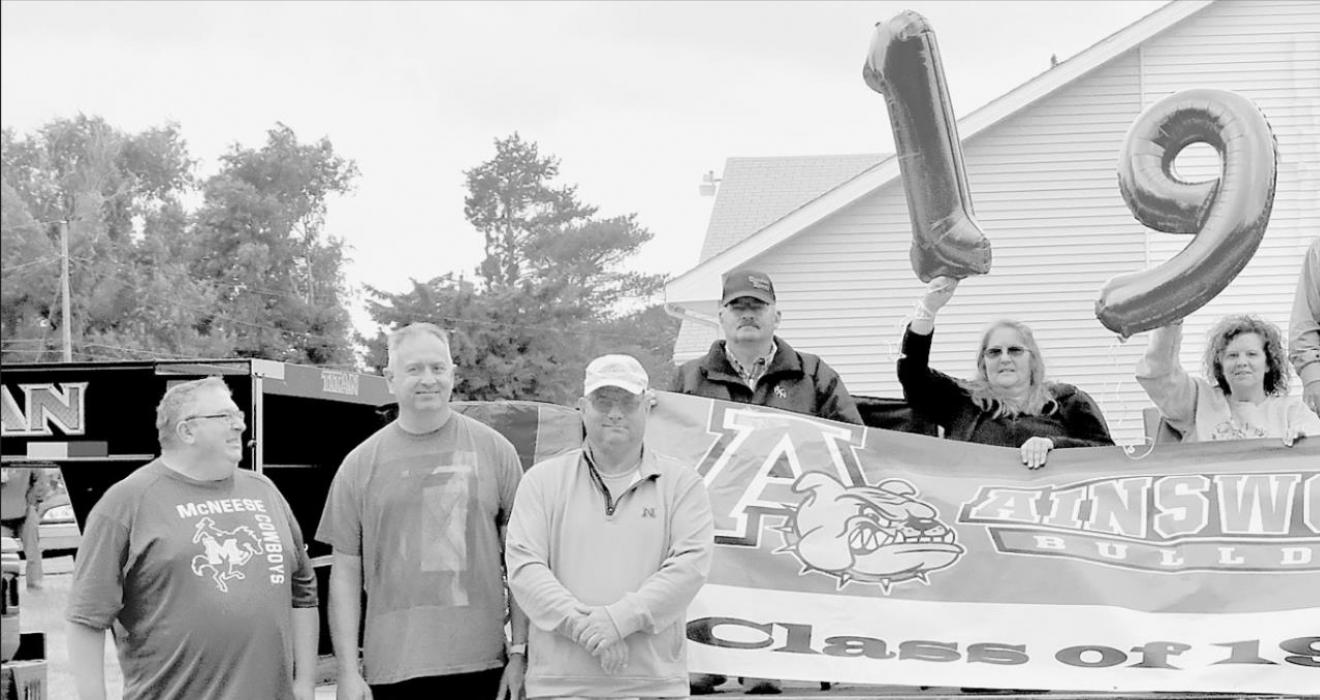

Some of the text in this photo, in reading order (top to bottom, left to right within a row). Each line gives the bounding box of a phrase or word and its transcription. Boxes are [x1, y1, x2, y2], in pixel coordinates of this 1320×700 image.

[863, 10, 991, 281] 1
[1095, 88, 1278, 336] 9
[254, 513, 285, 584] COWBOYS
[686, 616, 1030, 666] Class
[1055, 641, 1192, 670] of
